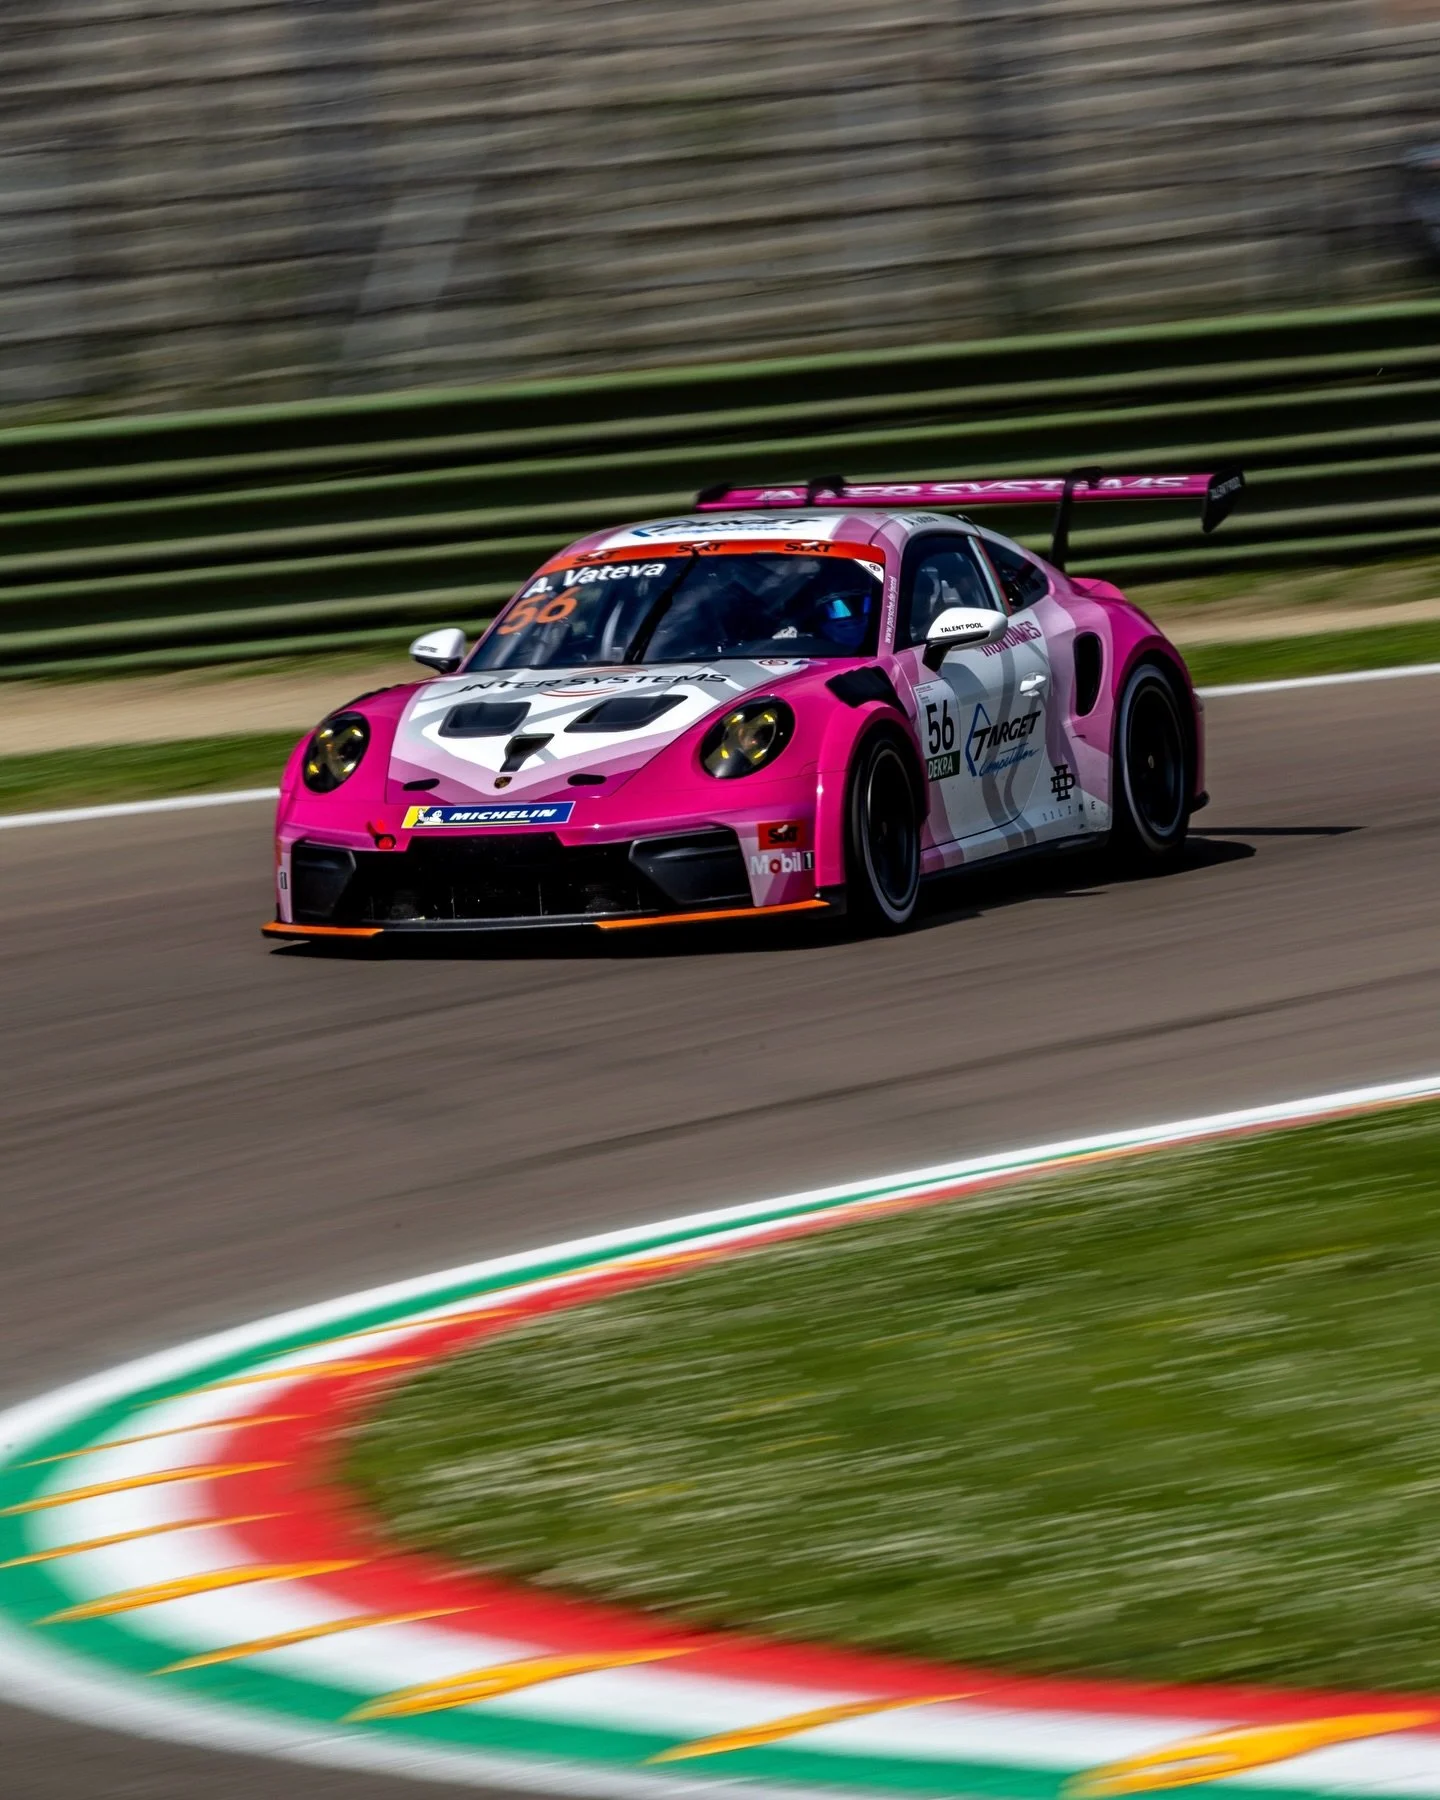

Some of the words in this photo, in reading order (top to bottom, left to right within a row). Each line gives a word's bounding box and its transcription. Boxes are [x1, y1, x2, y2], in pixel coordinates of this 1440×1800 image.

[784, 541, 836, 554] SIXT
[522, 577, 553, 598] A.
[563, 563, 667, 587] Vateva
[496, 586, 583, 636] 56
[940, 624, 965, 634] TALENT
[966, 622, 984, 630] POOL
[925, 699, 955, 755] 56
[972, 710, 1042, 762] TARGET
[928, 755, 954, 779] DEKRA
[450, 808, 557, 821] MICHELIN
[750, 851, 802, 876] Mobil
